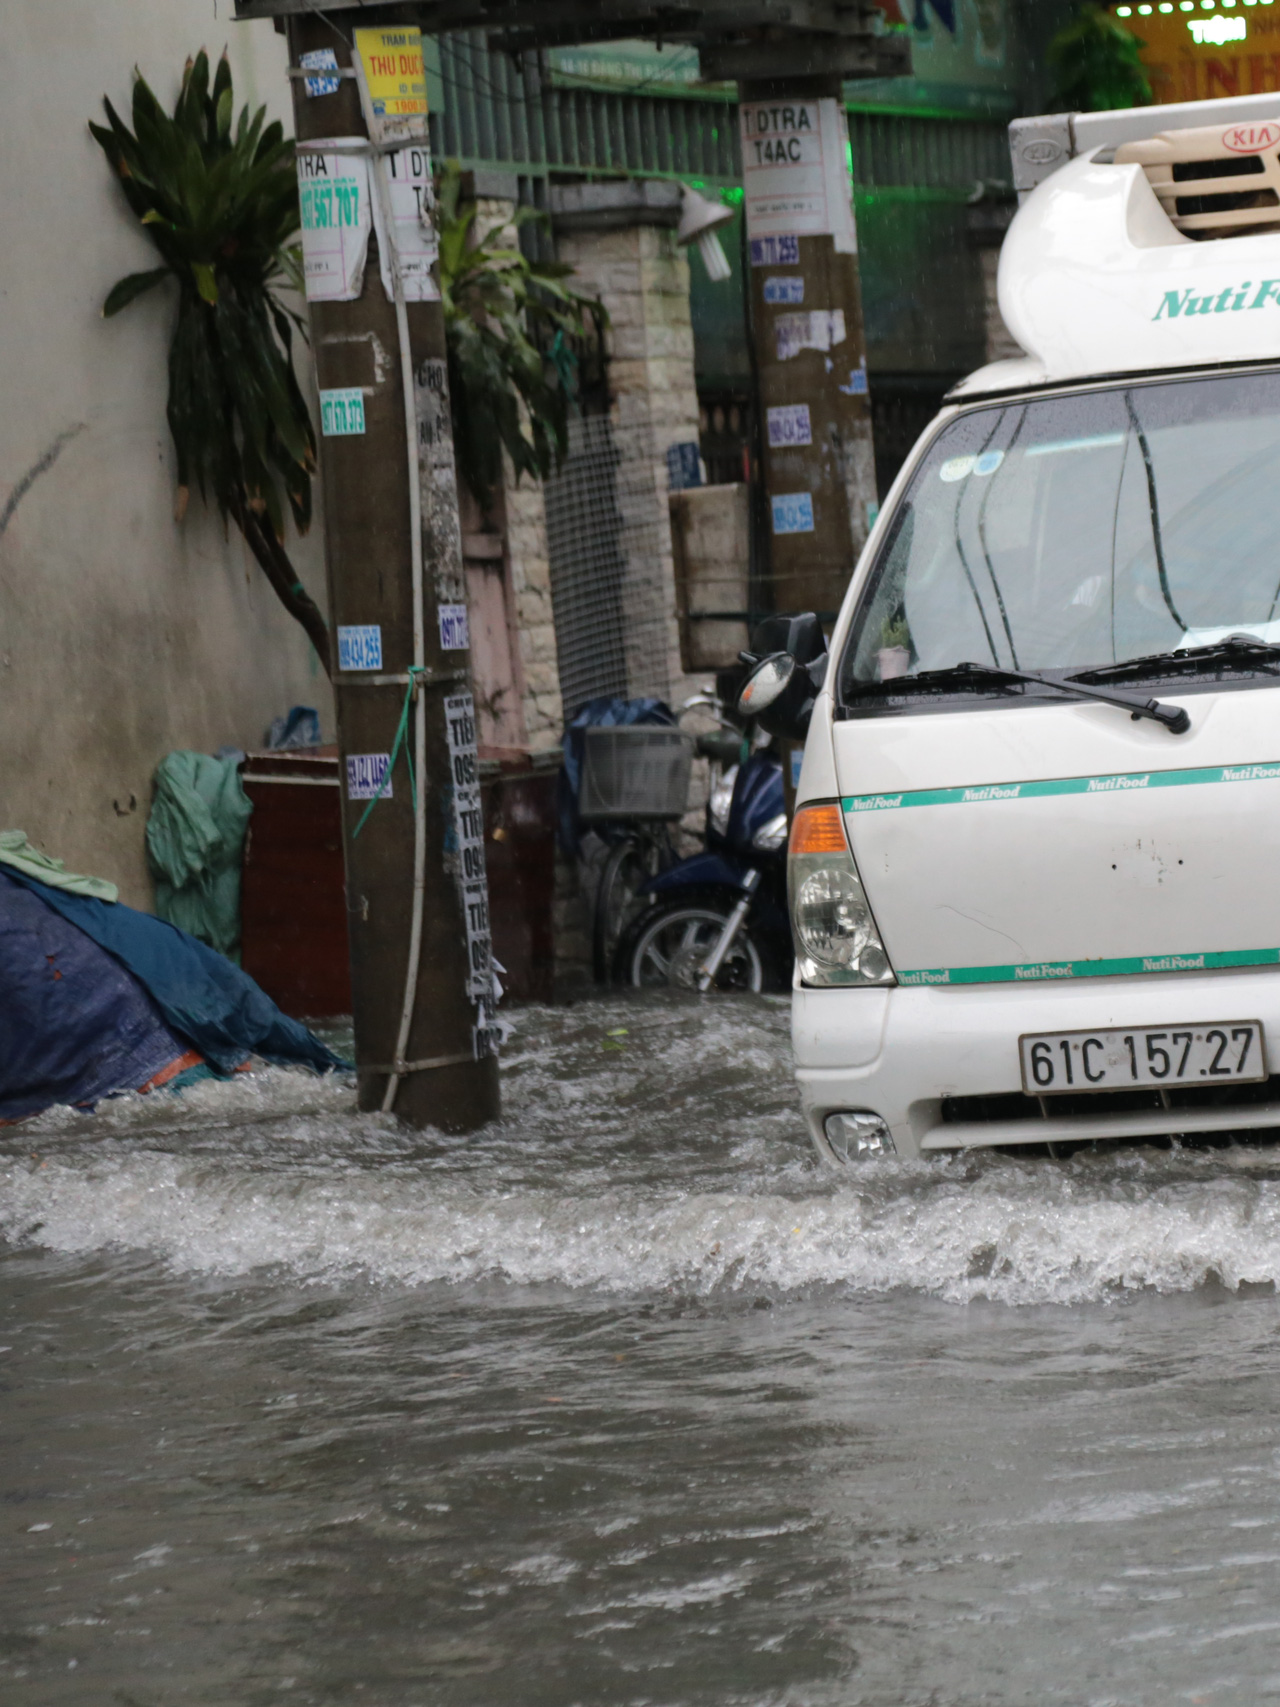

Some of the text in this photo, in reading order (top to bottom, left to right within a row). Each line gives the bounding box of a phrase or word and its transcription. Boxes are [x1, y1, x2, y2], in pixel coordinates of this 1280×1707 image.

[756, 106, 812, 132] DTRA
[754, 137, 802, 165] T4AC
[851, 795, 903, 812] NutiFood
[962, 785, 1021, 802] NutiFood
[1086, 775, 1150, 792] NutiFood
[1014, 963, 1074, 979] NutiFood
[1143, 955, 1206, 971] NutiFood
[1030, 1027, 1254, 1087] 61C 157.27
